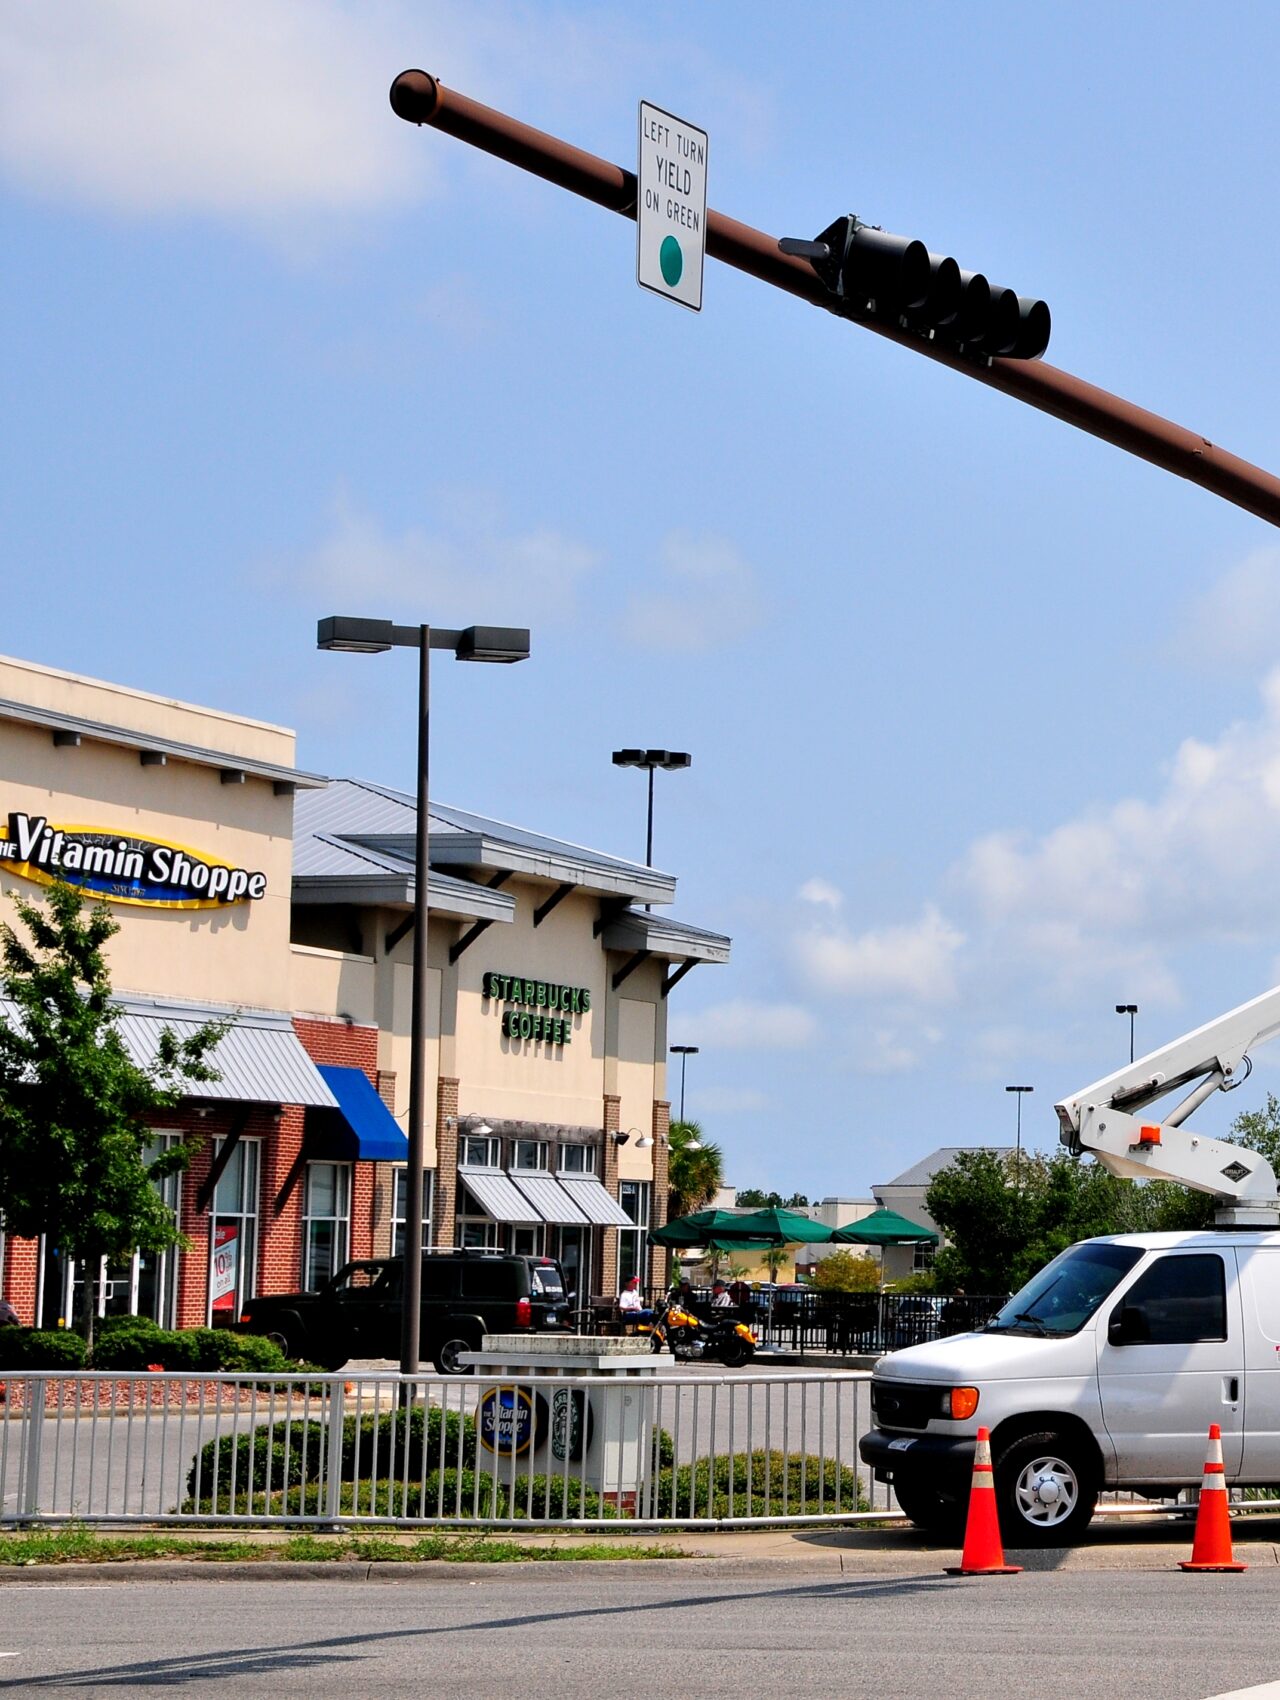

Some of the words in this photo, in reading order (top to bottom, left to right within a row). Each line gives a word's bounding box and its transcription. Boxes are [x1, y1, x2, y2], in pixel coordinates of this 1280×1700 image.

[643, 117, 669, 149] LEFT
[676, 133, 704, 166] TURN
[656, 155, 691, 196] YIELD
[645, 188, 659, 213] ON
[667, 199, 699, 233] GREEN
[16, 813, 145, 880] Vitamin
[147, 847, 267, 902] Shoppe
[484, 973, 592, 1014] STARBUCKS
[503, 1011, 573, 1045] COFFEE
[491, 1401, 528, 1420] Vtain
